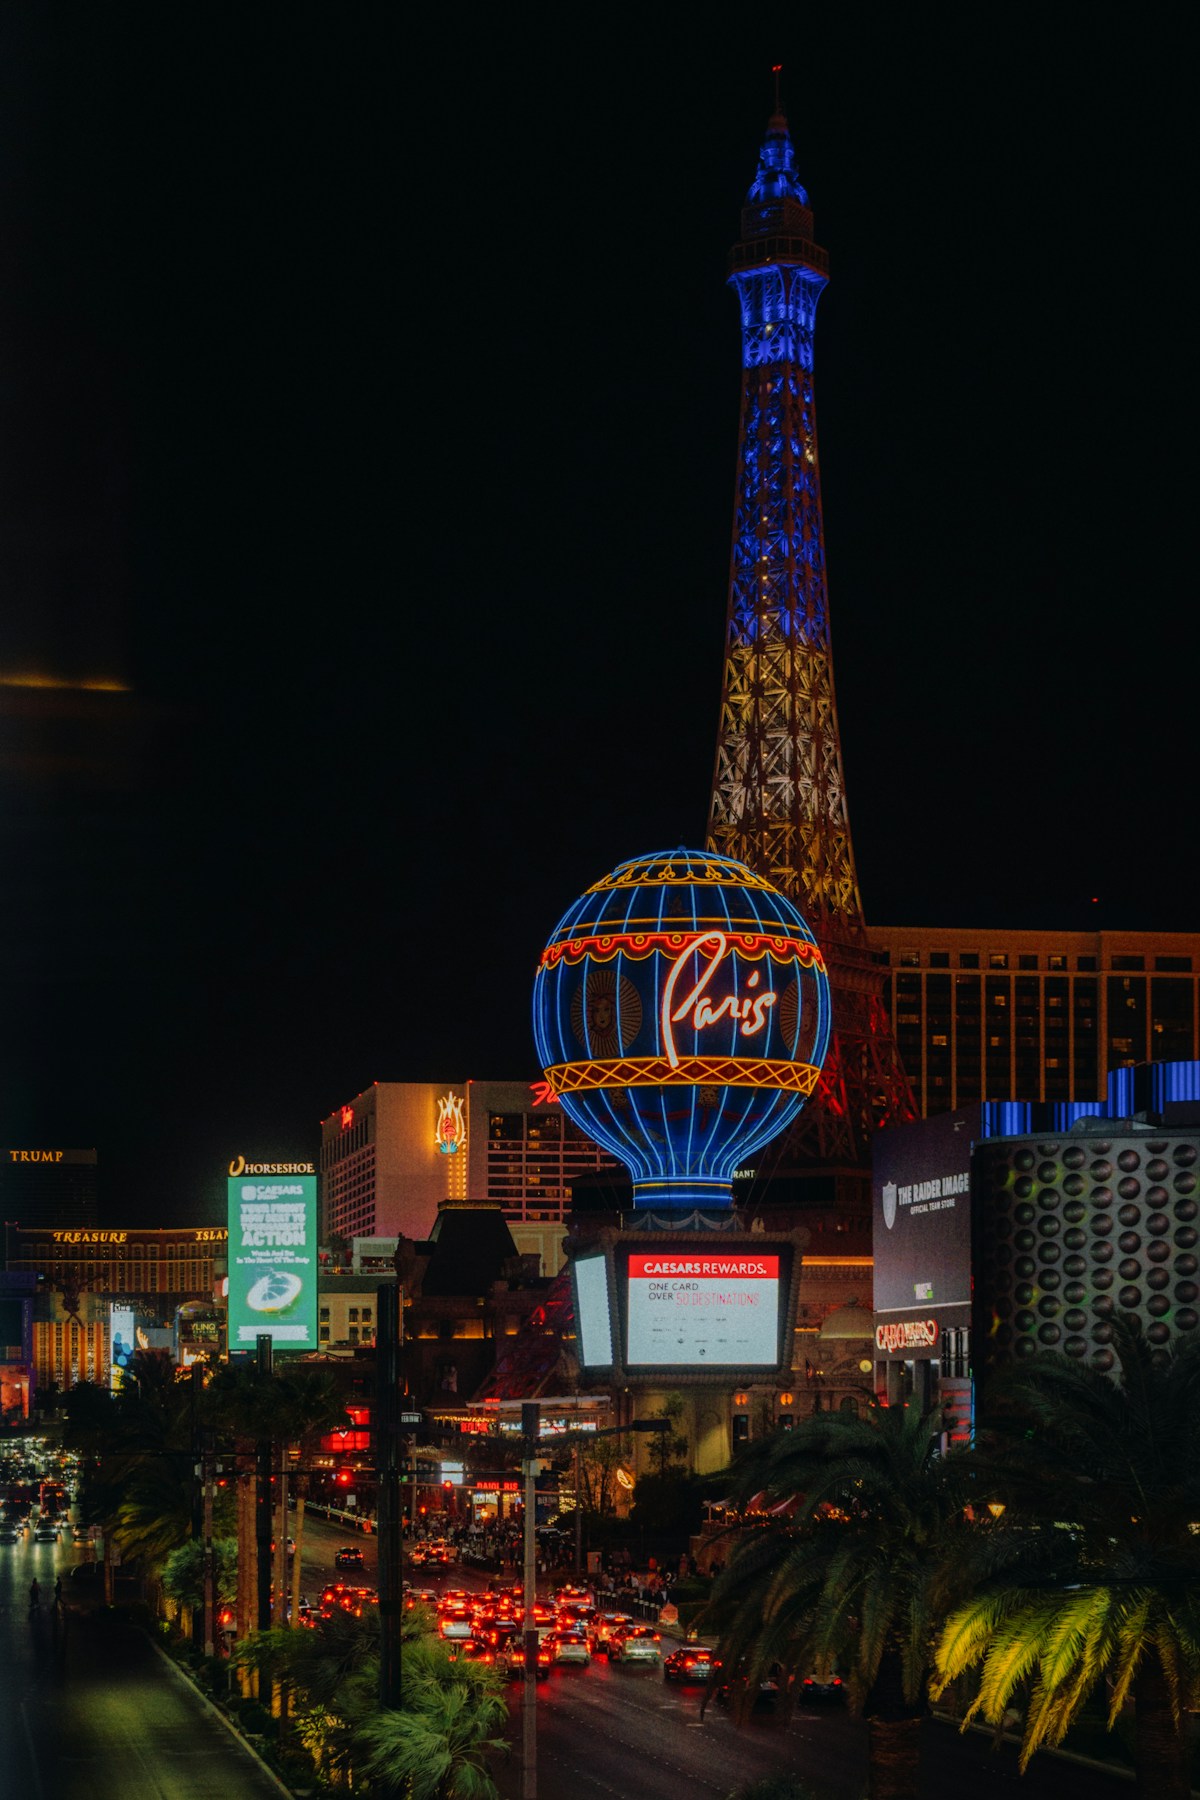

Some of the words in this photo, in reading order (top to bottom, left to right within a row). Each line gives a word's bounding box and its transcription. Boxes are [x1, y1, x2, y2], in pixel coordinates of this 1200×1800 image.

[661, 930, 777, 1069] Paris
[10, 1150, 64, 1162] TRUMP
[256, 1185, 303, 1195] CAESARS
[898, 1185, 912, 1206] THE
[913, 1179, 941, 1203] RAIDER
[942, 1172, 969, 1196] IMAGE
[910, 1204, 929, 1215] OFFICIAL
[929, 1201, 941, 1211] TEAM
[941, 1198, 955, 1209] STORE
[53, 1232, 127, 1243] TREASURE
[241, 1231, 306, 1246] ACTION
[643, 1262, 701, 1274] CAESARS
[648, 1283, 668, 1291] ONE
[672, 1282, 699, 1291] CARD
[648, 1292, 674, 1301] OVER
[676, 1292, 689, 1306] 50
[692, 1292, 760, 1306] DESTINATIONS
[876, 1323, 905, 1353] CABO
